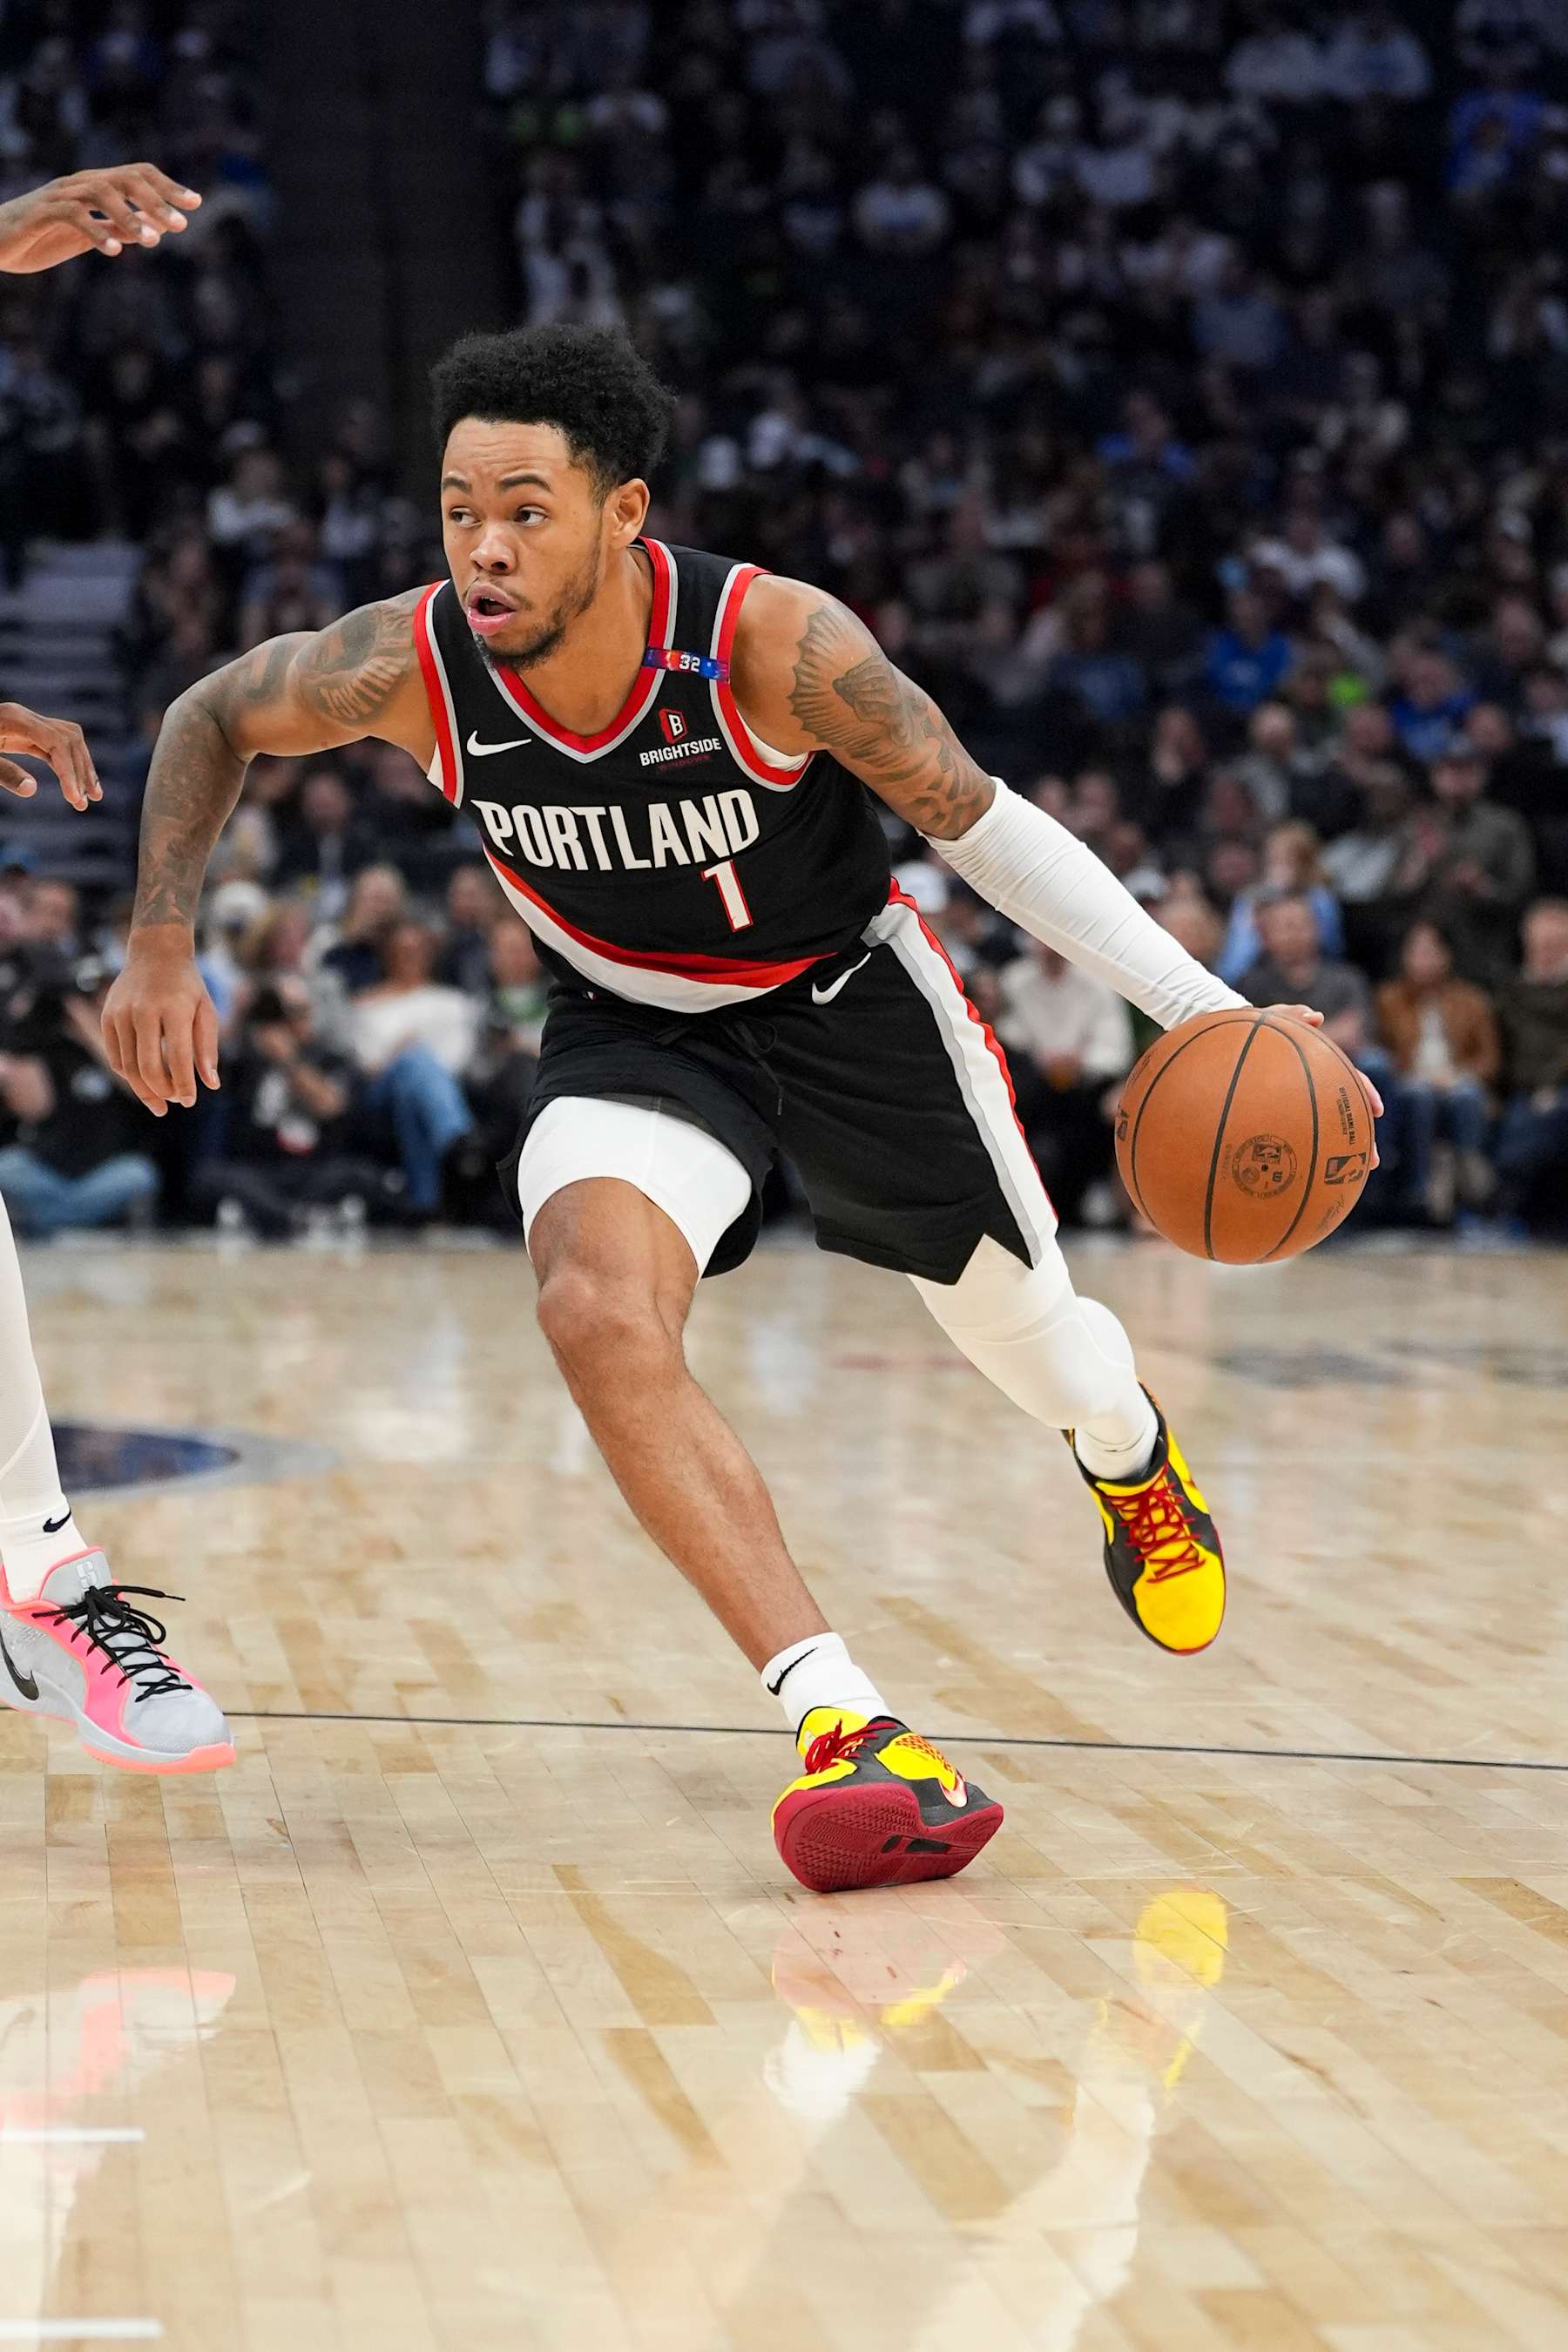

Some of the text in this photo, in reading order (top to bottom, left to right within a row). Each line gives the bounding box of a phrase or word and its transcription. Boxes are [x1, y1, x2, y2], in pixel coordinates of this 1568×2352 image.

[679, 655, 700, 672] 32
[639, 738, 722, 767] BRIGHTSIDE
[470, 789, 760, 871] PORTLAND
[700, 859, 754, 933] 1
